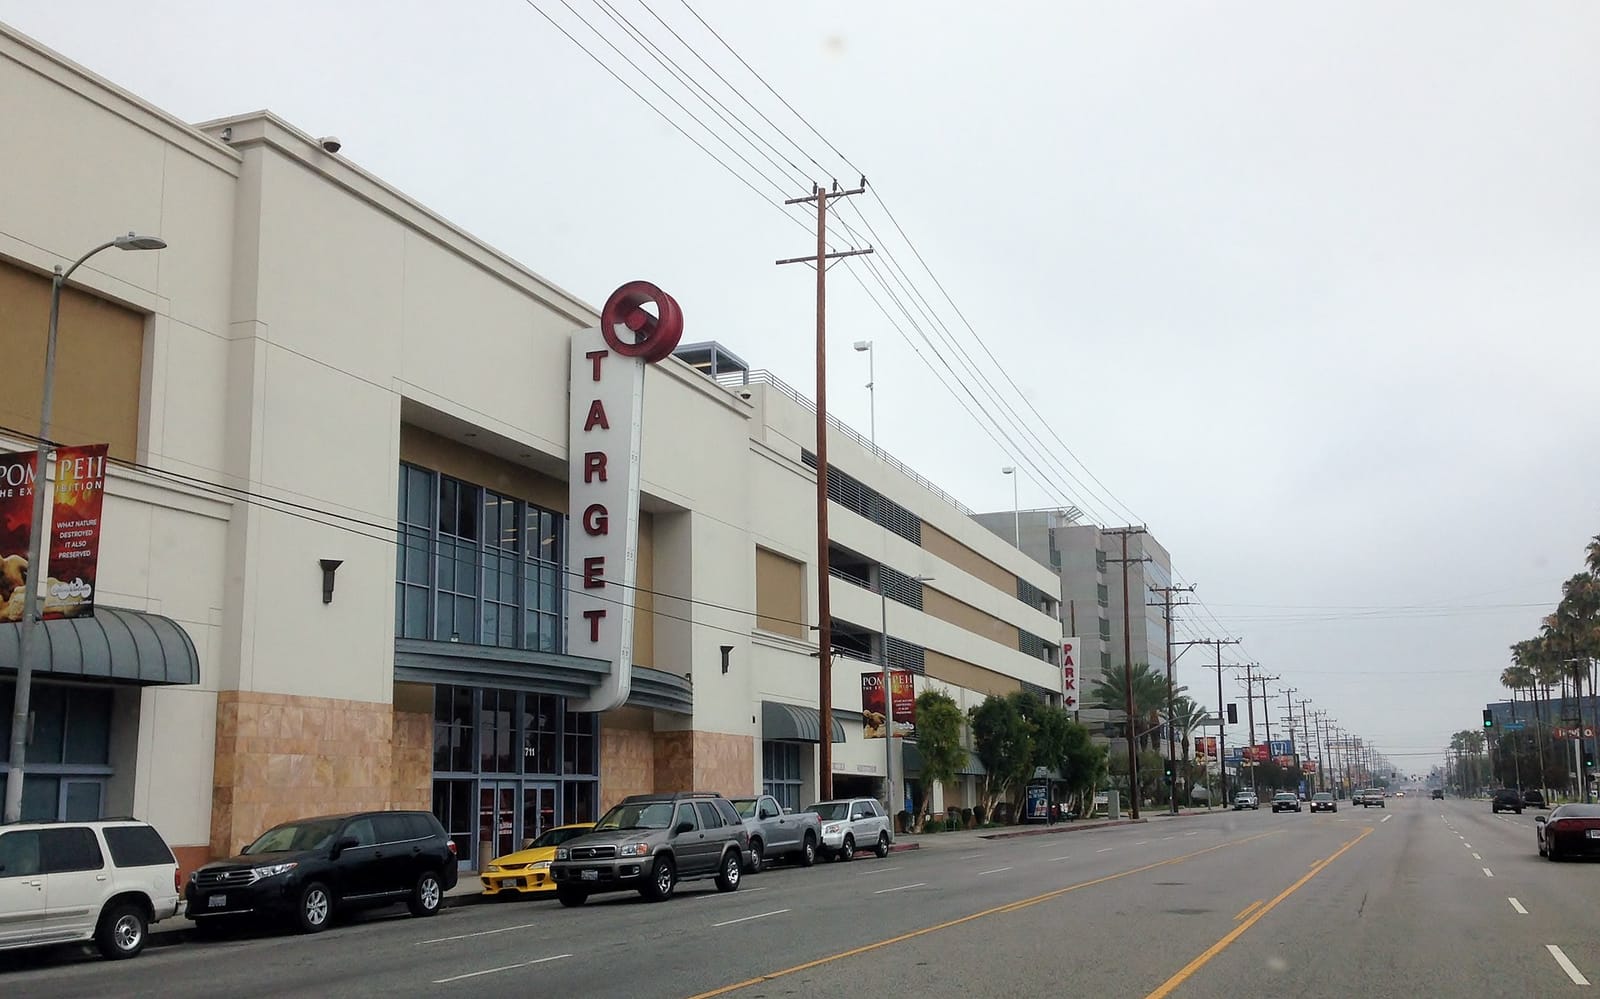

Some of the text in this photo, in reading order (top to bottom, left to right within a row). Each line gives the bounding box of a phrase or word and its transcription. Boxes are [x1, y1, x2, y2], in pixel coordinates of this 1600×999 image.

[582, 350, 610, 643] TARGET
[57, 519, 97, 529] WHAT NATURE
[59, 529, 93, 539] DESTROYED
[71, 540, 87, 548] ALSO
[58, 550, 91, 559] PRESERVED
[1063, 644, 1075, 690] PARK
[525, 747, 535, 757] 711
